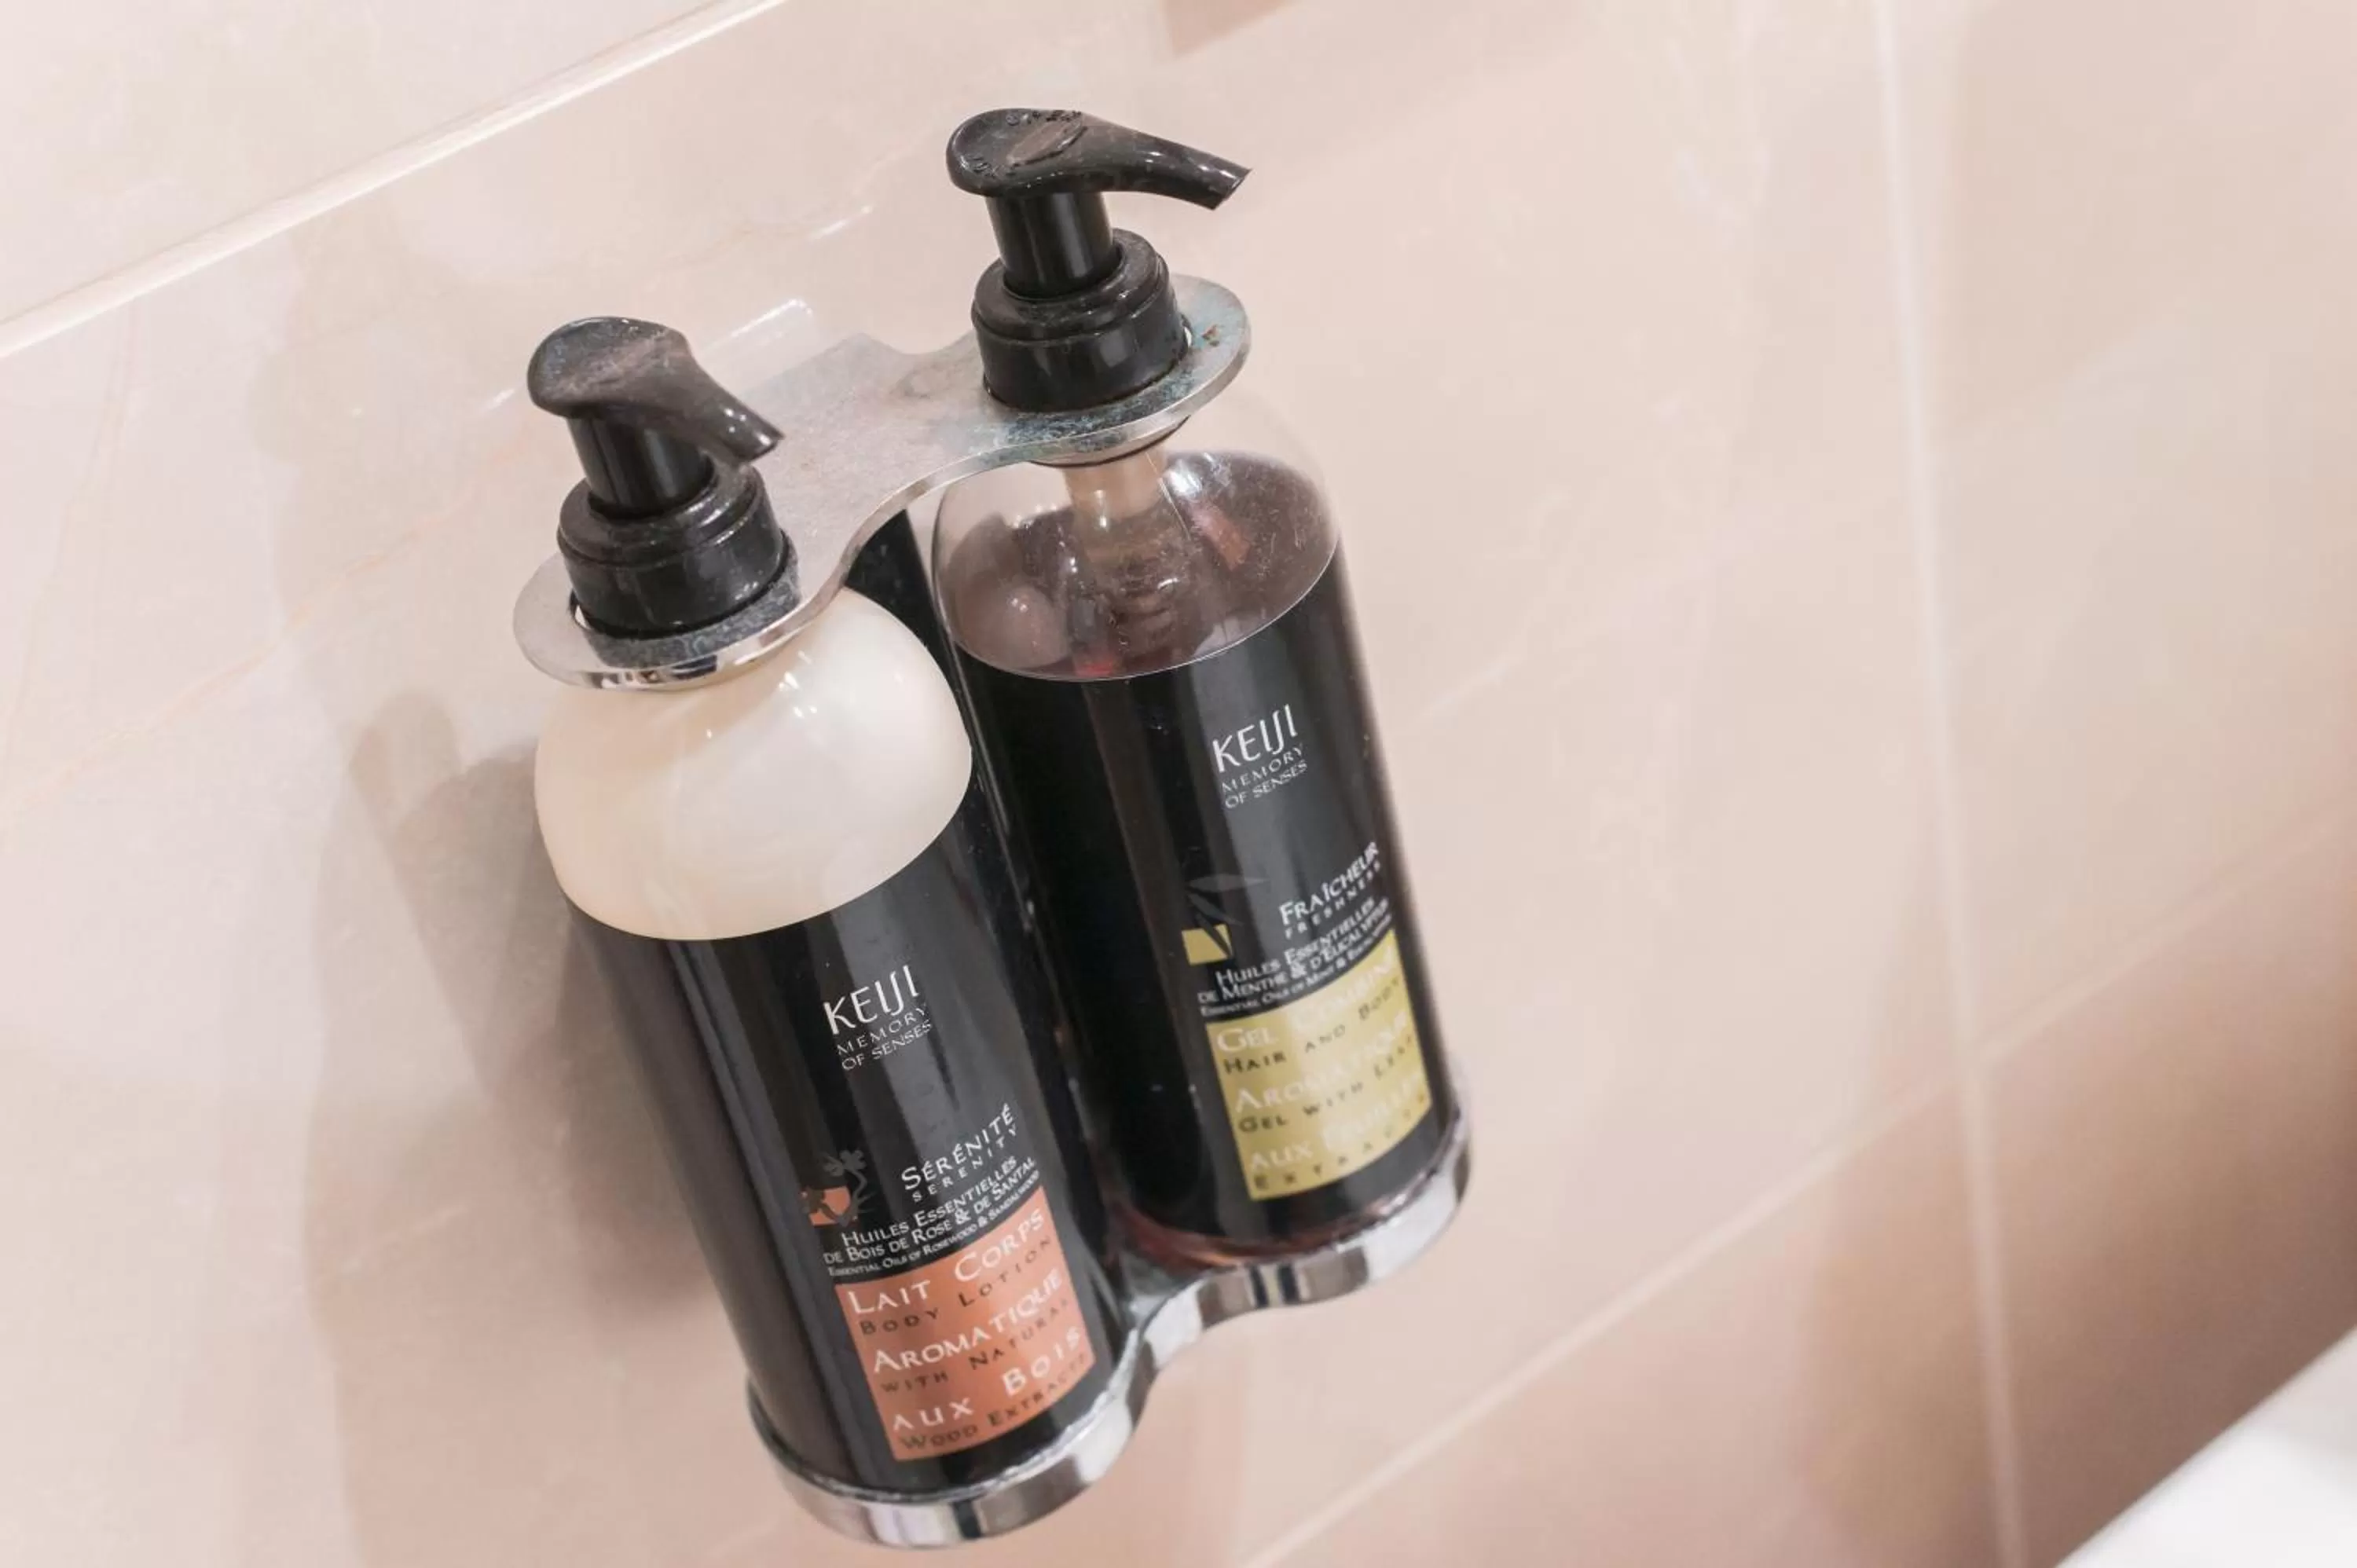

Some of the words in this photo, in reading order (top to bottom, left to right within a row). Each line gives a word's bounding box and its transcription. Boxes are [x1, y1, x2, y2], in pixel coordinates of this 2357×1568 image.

[1212, 704, 1299, 773] KEIJI
[1222, 742, 1304, 794] MEMORY
[1225, 792, 1248, 810] OF
[1252, 760, 1309, 798] SENSES
[1197, 991, 1219, 1003] DE
[1215, 958, 1281, 986] HUILES
[823, 965, 919, 1035] KEIJI
[837, 1004, 926, 1056] MEMORY
[841, 1055, 864, 1071] OF
[871, 1020, 933, 1061] SENSES
[1216, 1027, 1278, 1053] GEL
[1223, 1050, 1287, 1075] HAIR
[1304, 1024, 1346, 1053] AND
[901, 1102, 1014, 1191] SÉRÉNITÉ
[1238, 1114, 1290, 1135] GEL
[912, 1123, 1017, 1203] SERENITY
[1249, 1141, 1315, 1171] AUX
[823, 1251, 844, 1265] DE
[846, 1244, 885, 1262] BOIS
[889, 1237, 907, 1251] DE
[911, 1218, 953, 1245] ROSE
[955, 1207, 971, 1225] &
[973, 1195, 992, 1214] DE
[992, 1156, 1036, 1201] SANTAL
[841, 1221, 910, 1247] HUILES
[914, 1156, 1017, 1227] ESSENTIELLES
[849, 1279, 931, 1315] LAIT
[955, 1208, 1044, 1282] CORPS
[908, 1251, 920, 1261] OF
[860, 1306, 939, 1336] BODY
[958, 1236, 1050, 1308] LOTION
[874, 1269, 1063, 1374] AROMATIQUE
[880, 1371, 949, 1394] WITH
[893, 1397, 974, 1433] AUX
[1002, 1326, 1081, 1396] BOIS
[900, 1424, 978, 1450] WOOD
